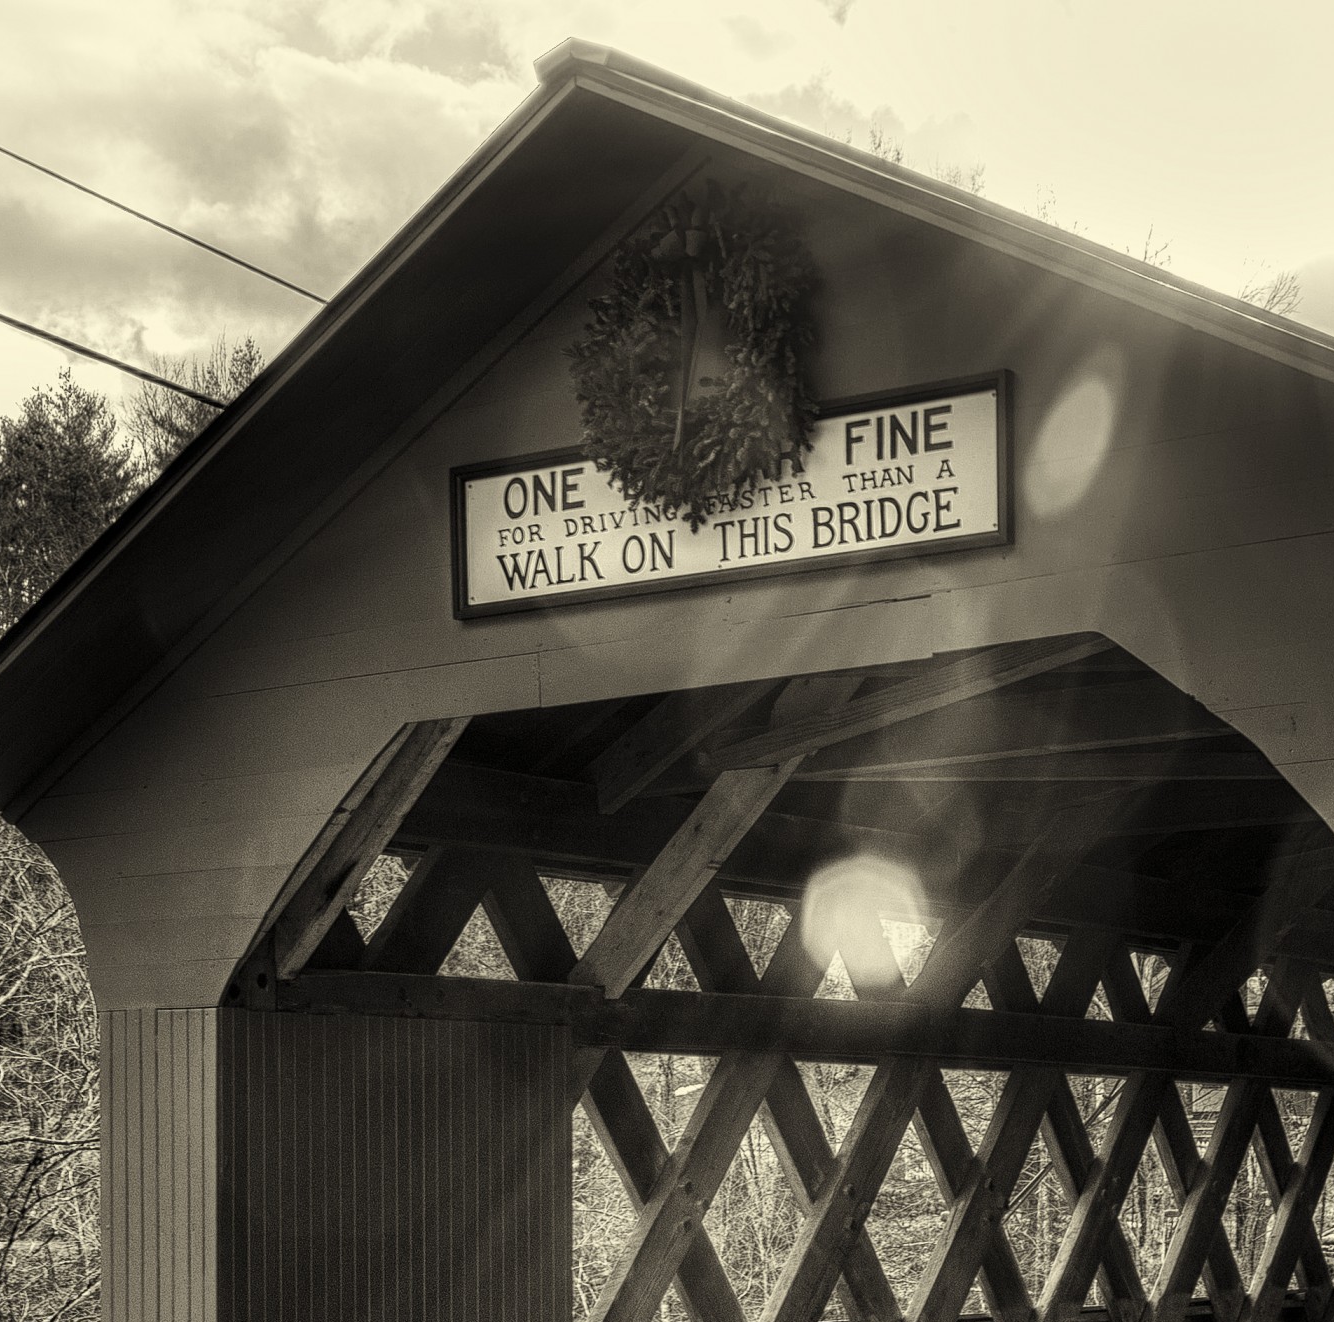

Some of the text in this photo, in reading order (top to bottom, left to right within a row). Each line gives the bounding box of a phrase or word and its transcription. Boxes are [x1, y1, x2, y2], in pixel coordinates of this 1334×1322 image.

[498, 459, 955, 547] FOR DRIVING FASTER THAN A
[503, 467, 586, 519] ONE
[845, 405, 953, 465] FINE
[496, 486, 961, 591] WALK ON THIS BRIDGE
